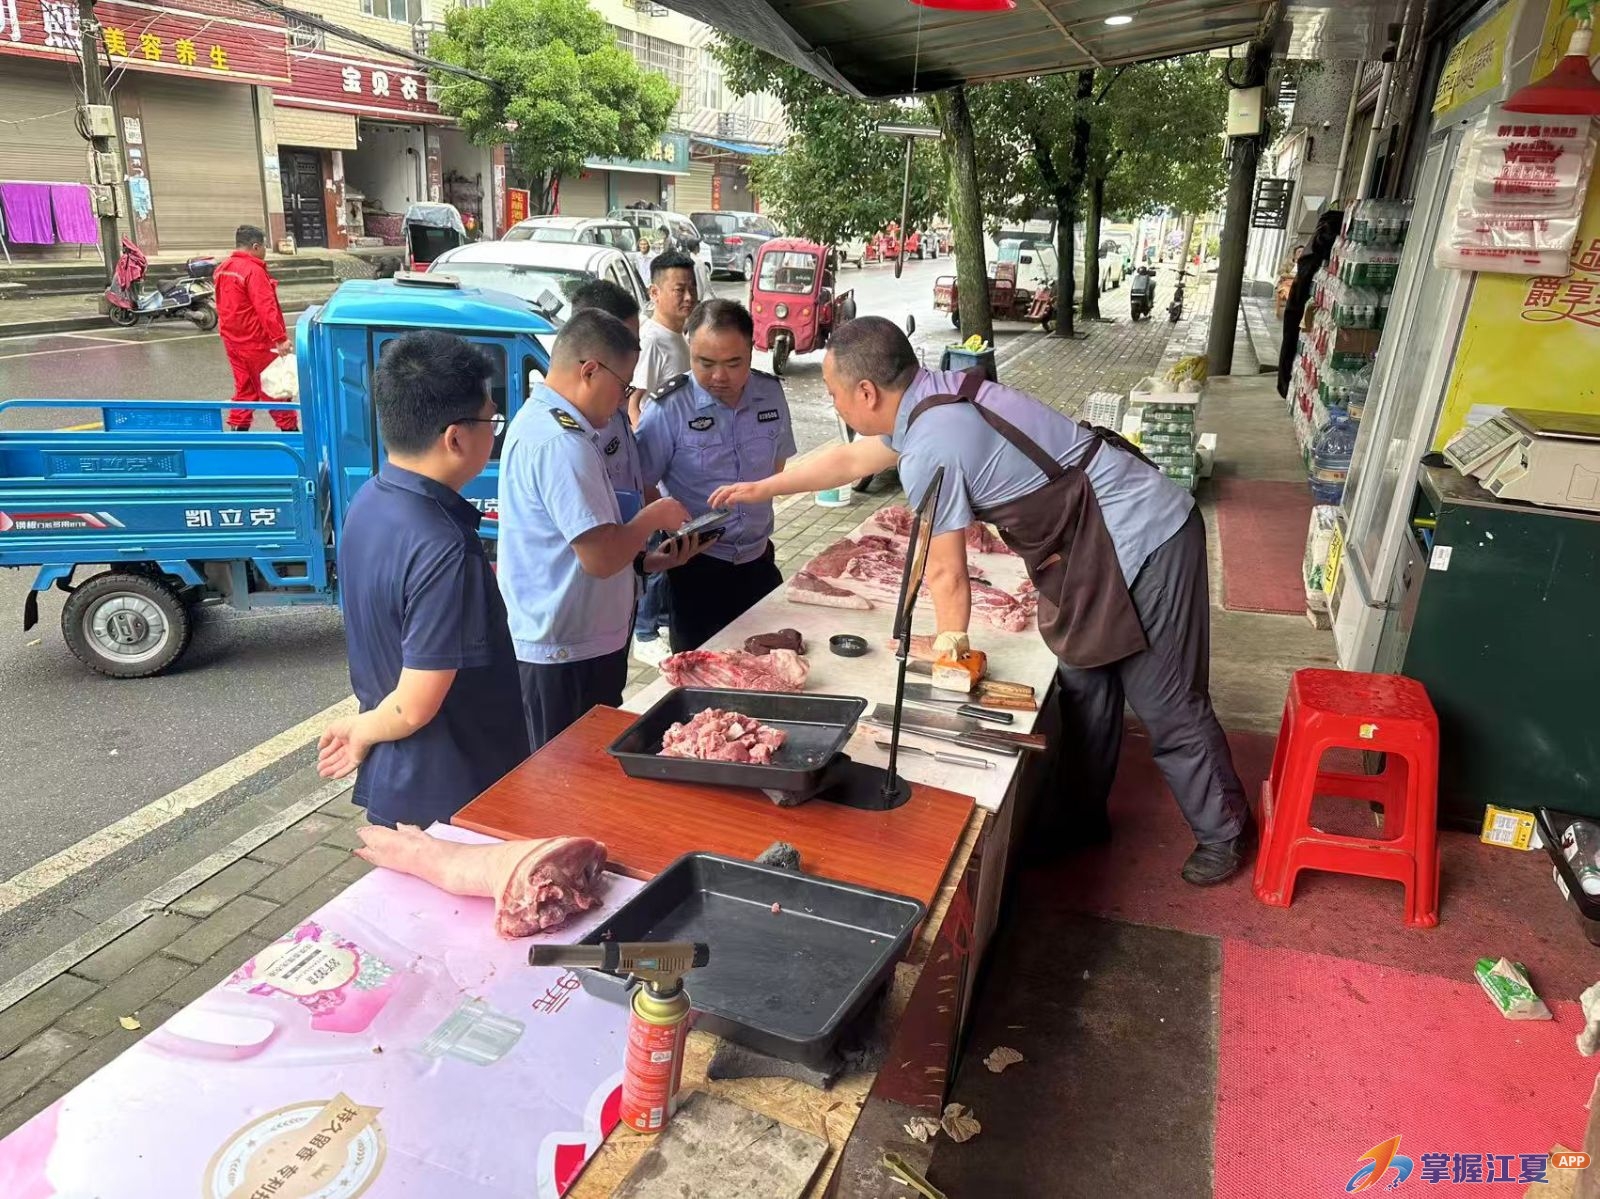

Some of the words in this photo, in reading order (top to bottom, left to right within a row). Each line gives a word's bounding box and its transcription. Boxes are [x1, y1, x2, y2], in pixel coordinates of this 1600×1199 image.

[103, 26, 230, 71] 美容养生
[342, 65, 419, 100] 宝贝衣
[185, 508, 277, 527] 凯立克
[294, 1104, 359, 1163] 持久留香
